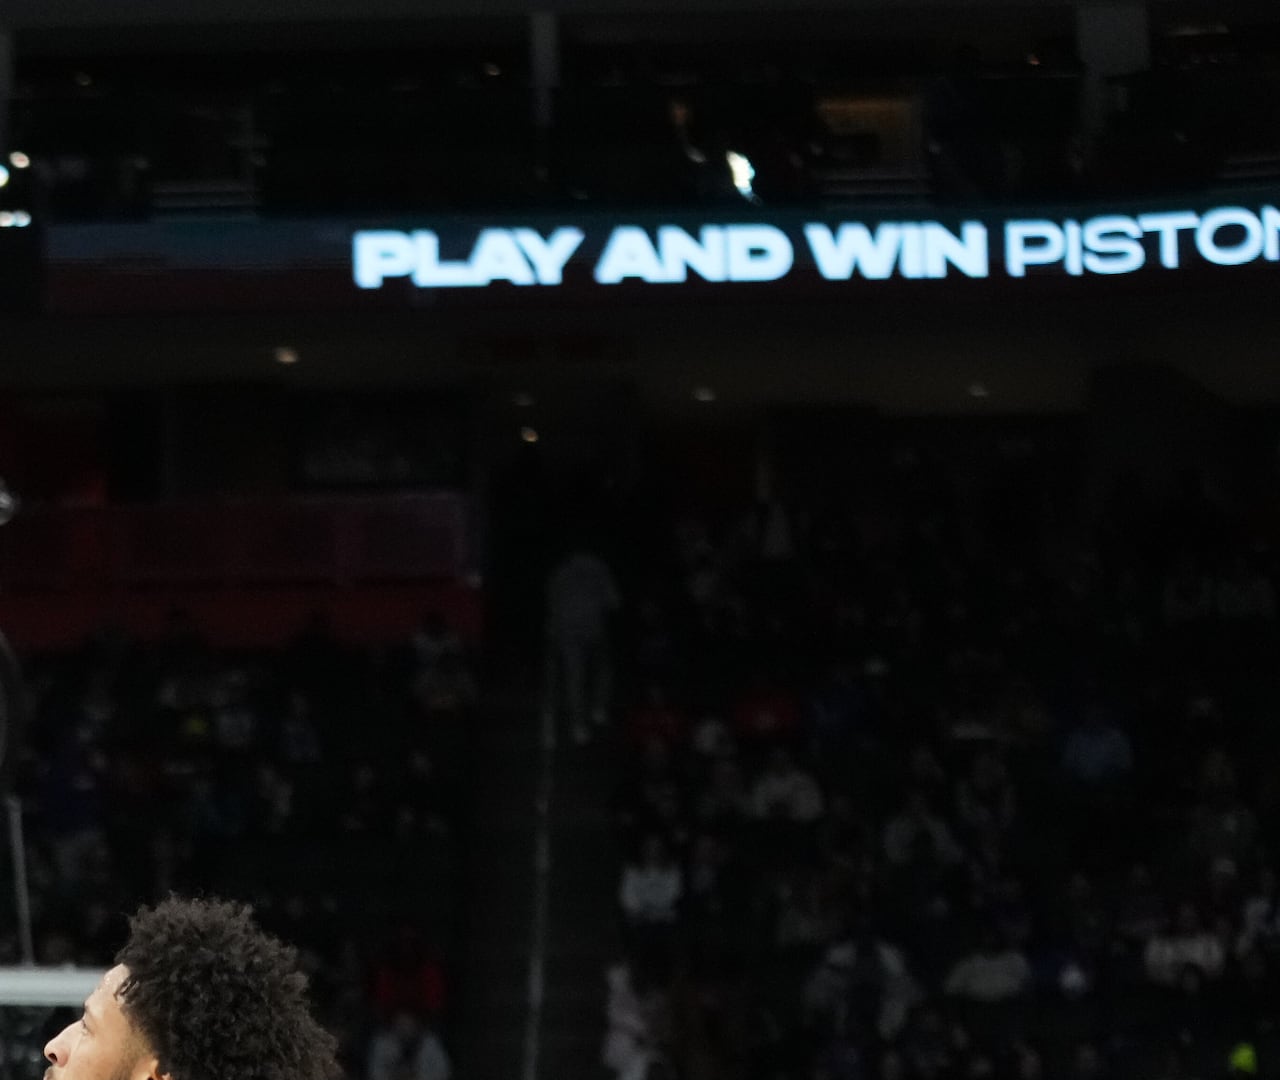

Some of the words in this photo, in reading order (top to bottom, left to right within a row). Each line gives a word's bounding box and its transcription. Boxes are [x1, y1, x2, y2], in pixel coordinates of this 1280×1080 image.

[352, 228, 584, 288] PLAY
[595, 223, 794, 283] AND
[804, 221, 989, 280] WIN
